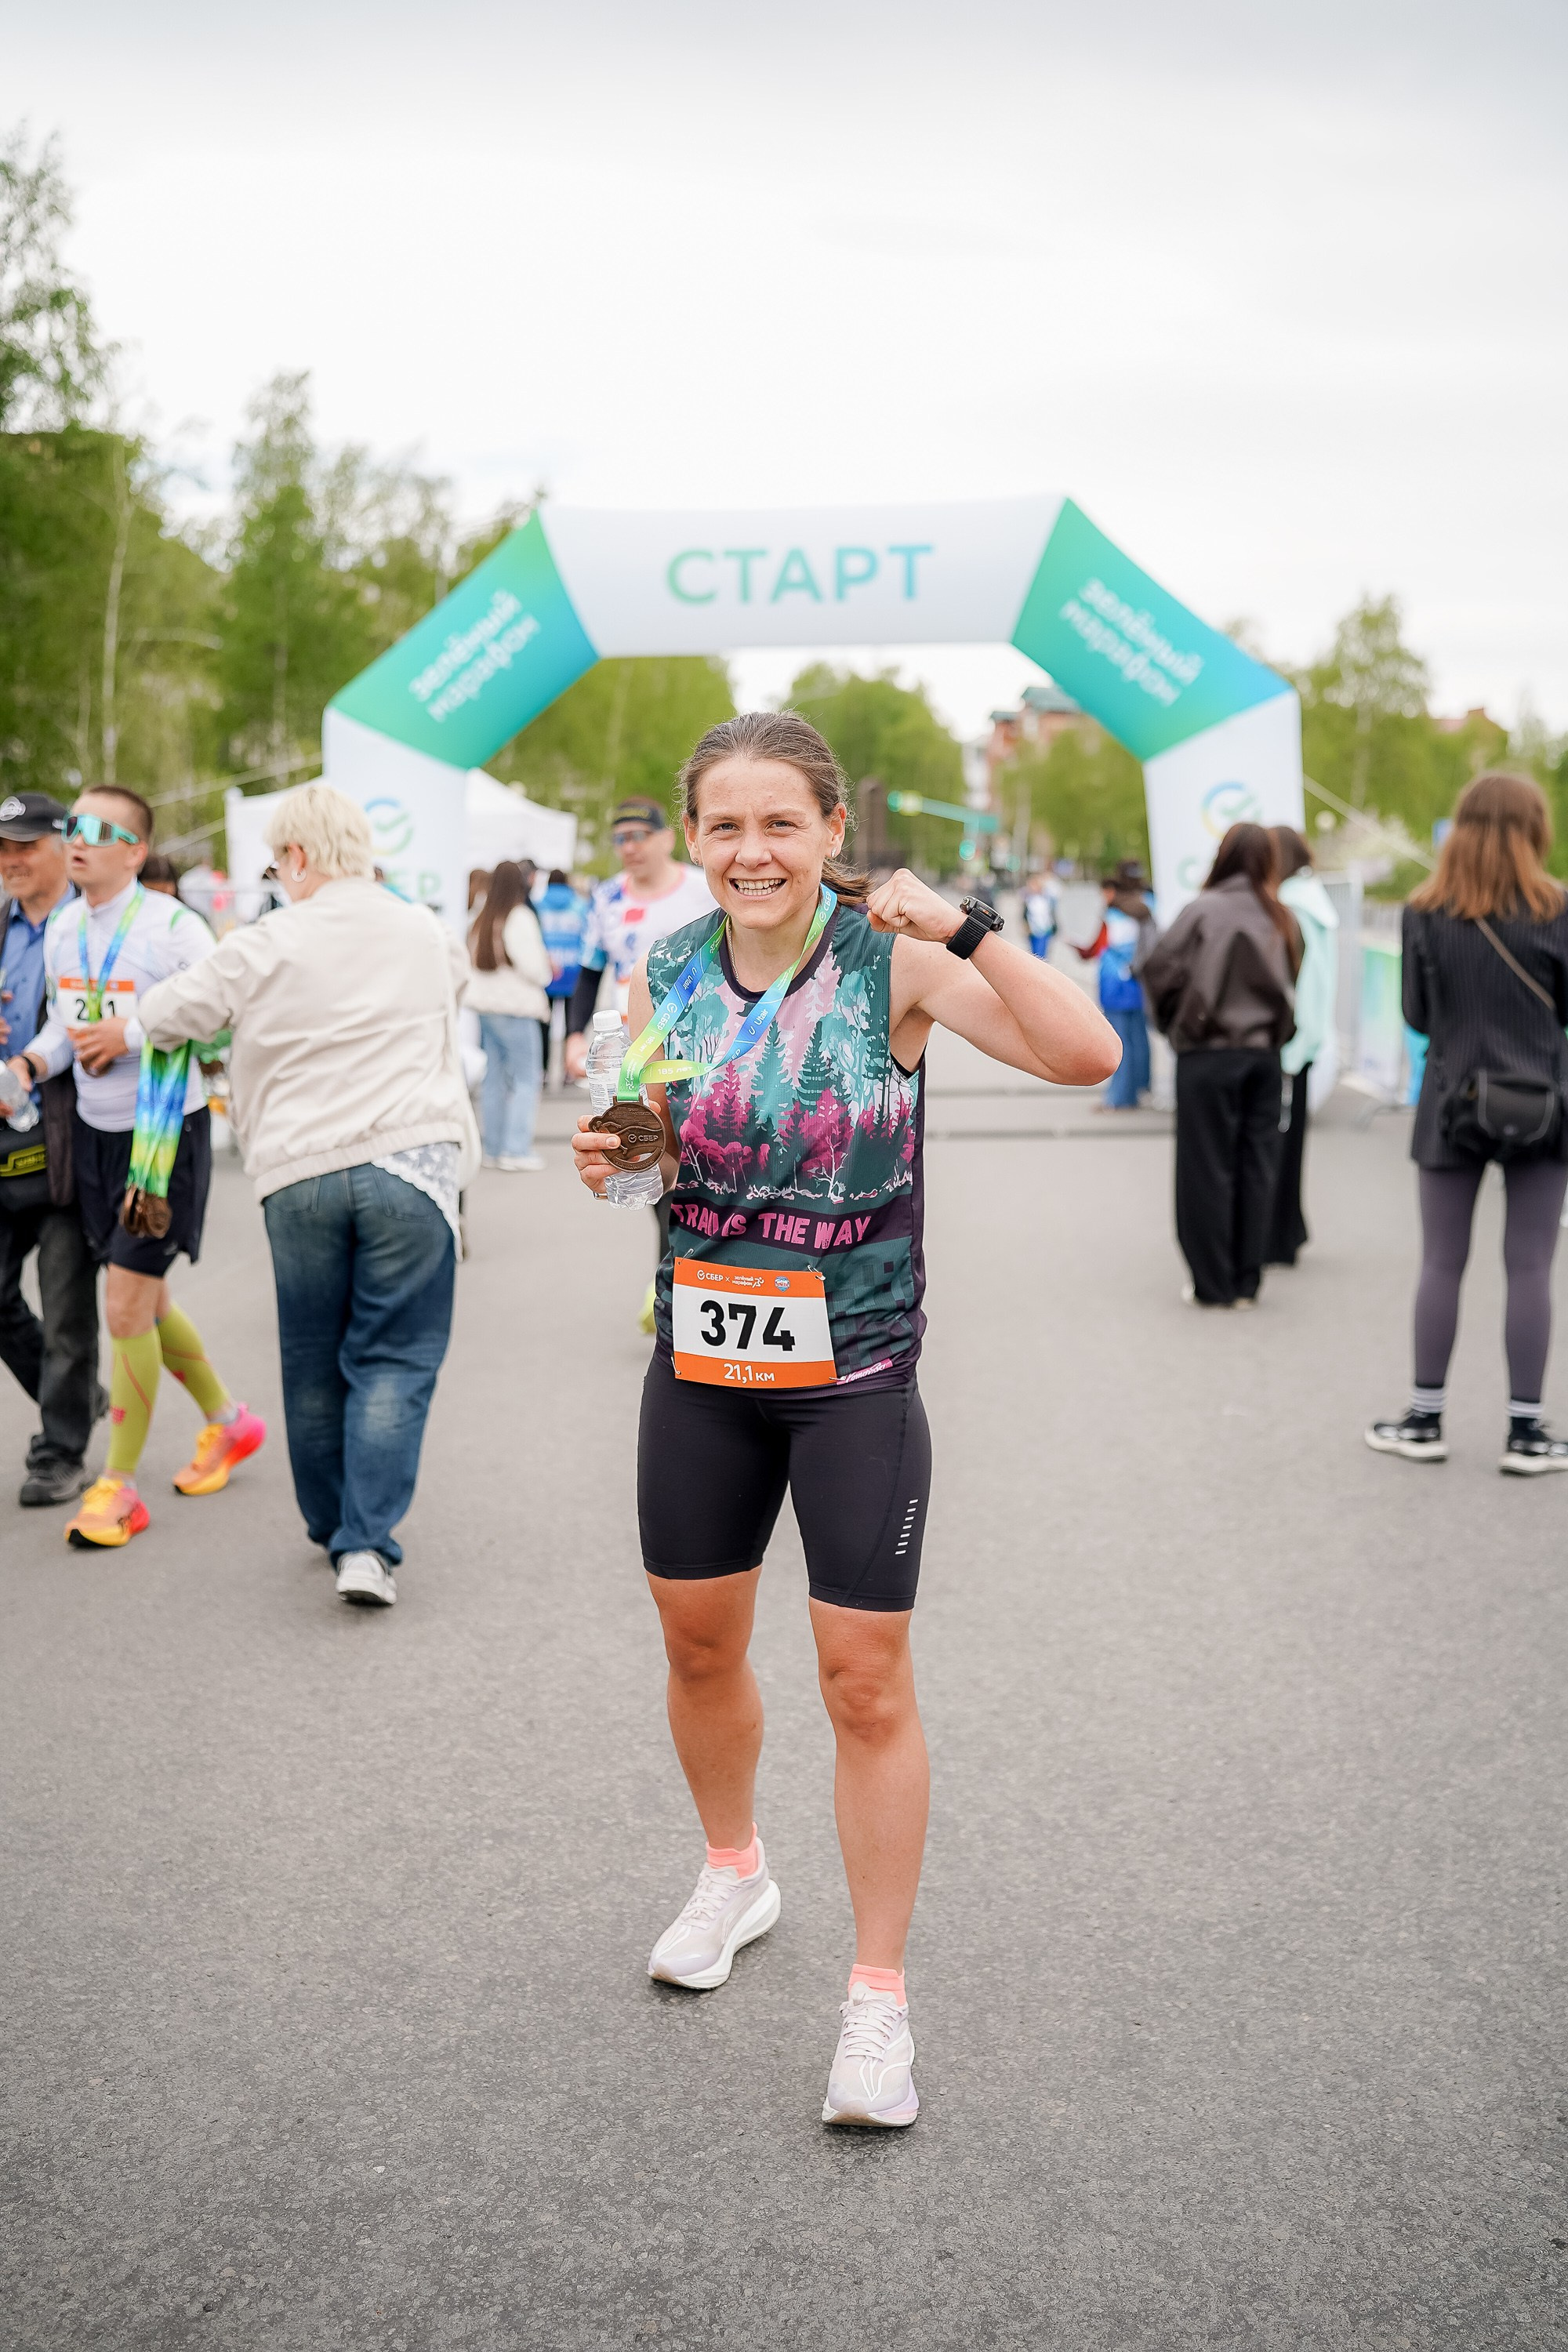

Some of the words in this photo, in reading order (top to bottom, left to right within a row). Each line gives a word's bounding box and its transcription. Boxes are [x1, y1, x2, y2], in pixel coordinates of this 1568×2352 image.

[667, 545, 932, 604] СТАРТ
[75, 999, 115, 1021] 21
[753, 1008, 769, 1026] Utair
[657, 1013, 670, 1031] СБЕР
[758, 1213, 811, 1245] THE
[814, 1216, 872, 1250] WAY
[706, 1272, 724, 1282] СБЕР
[700, 1300, 796, 1352] 374
[724, 1363, 753, 1384] 21,1
[755, 1372, 775, 1381] км
